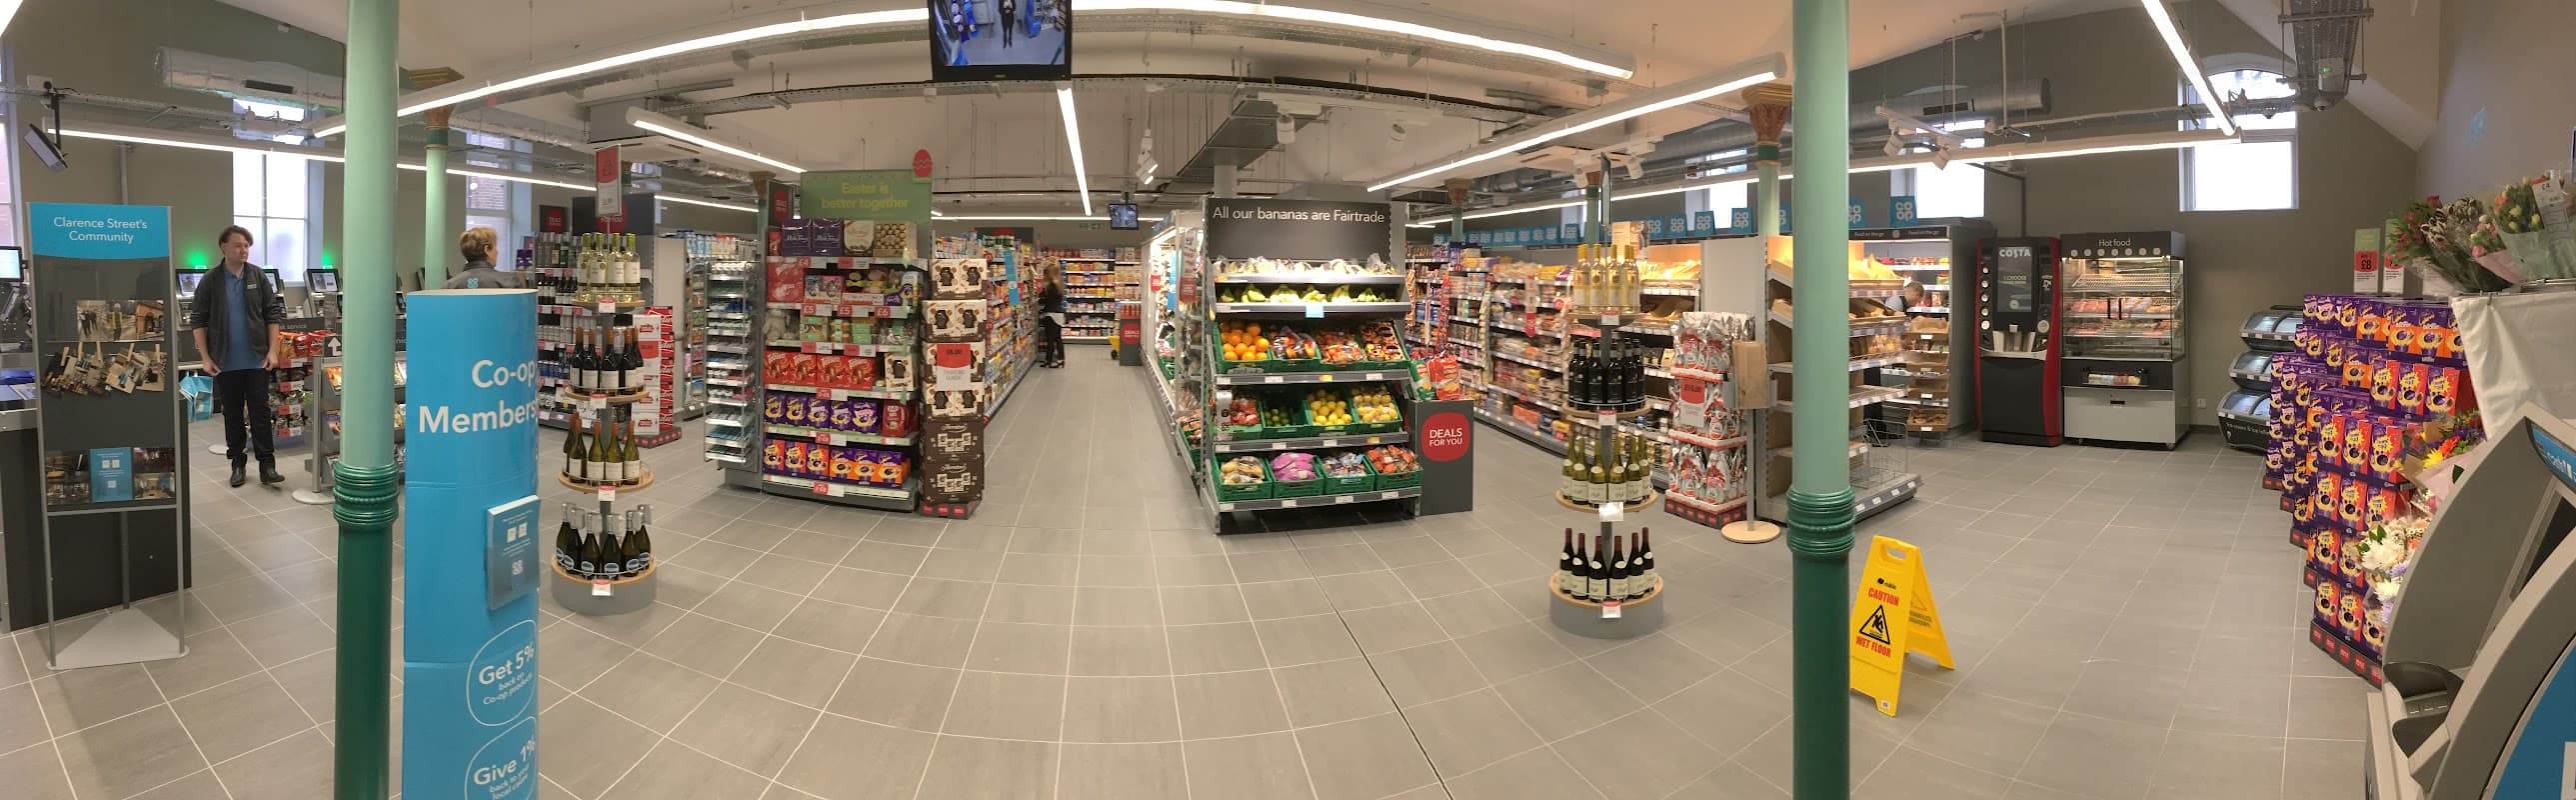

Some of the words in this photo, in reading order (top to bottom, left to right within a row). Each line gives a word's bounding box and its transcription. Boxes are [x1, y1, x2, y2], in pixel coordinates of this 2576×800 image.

[842, 182, 876, 194] Easter
[880, 182, 889, 194] is
[821, 198, 857, 209] better
[859, 198, 909, 212] together
[1213, 207, 1230, 219] All
[1233, 210, 1254, 219] our
[1257, 207, 1308, 220] bananas
[1311, 211, 1330, 221] are
[1333, 209, 1385, 223] Fairtrade
[53, 216, 105, 228] Clarence
[106, 218, 148, 229] Street's
[68, 230, 134, 245] Community
[2098, 239, 2113, 247] Hot
[2113, 238, 2131, 247] food
[1999, 249, 2031, 259] COSTA
[2361, 259, 2372, 270] £8
[803, 305, 815, 314] £5
[840, 306, 850, 315] £5
[877, 308, 889, 316] £6
[471, 359, 536, 389] Co-op
[1429, 427, 1462, 439] DEALS
[1429, 439, 1445, 447] FOR
[1446, 437, 1463, 446] YOU
[1867, 586, 1900, 607] CAUTION
[1855, 635, 1870, 649] WET
[1870, 641, 1892, 658] FLOOR
[479, 659, 513, 685] Get
[516, 641, 535, 670] 5%
[474, 759, 518, 785] Give
[520, 734, 536, 763] 1%
